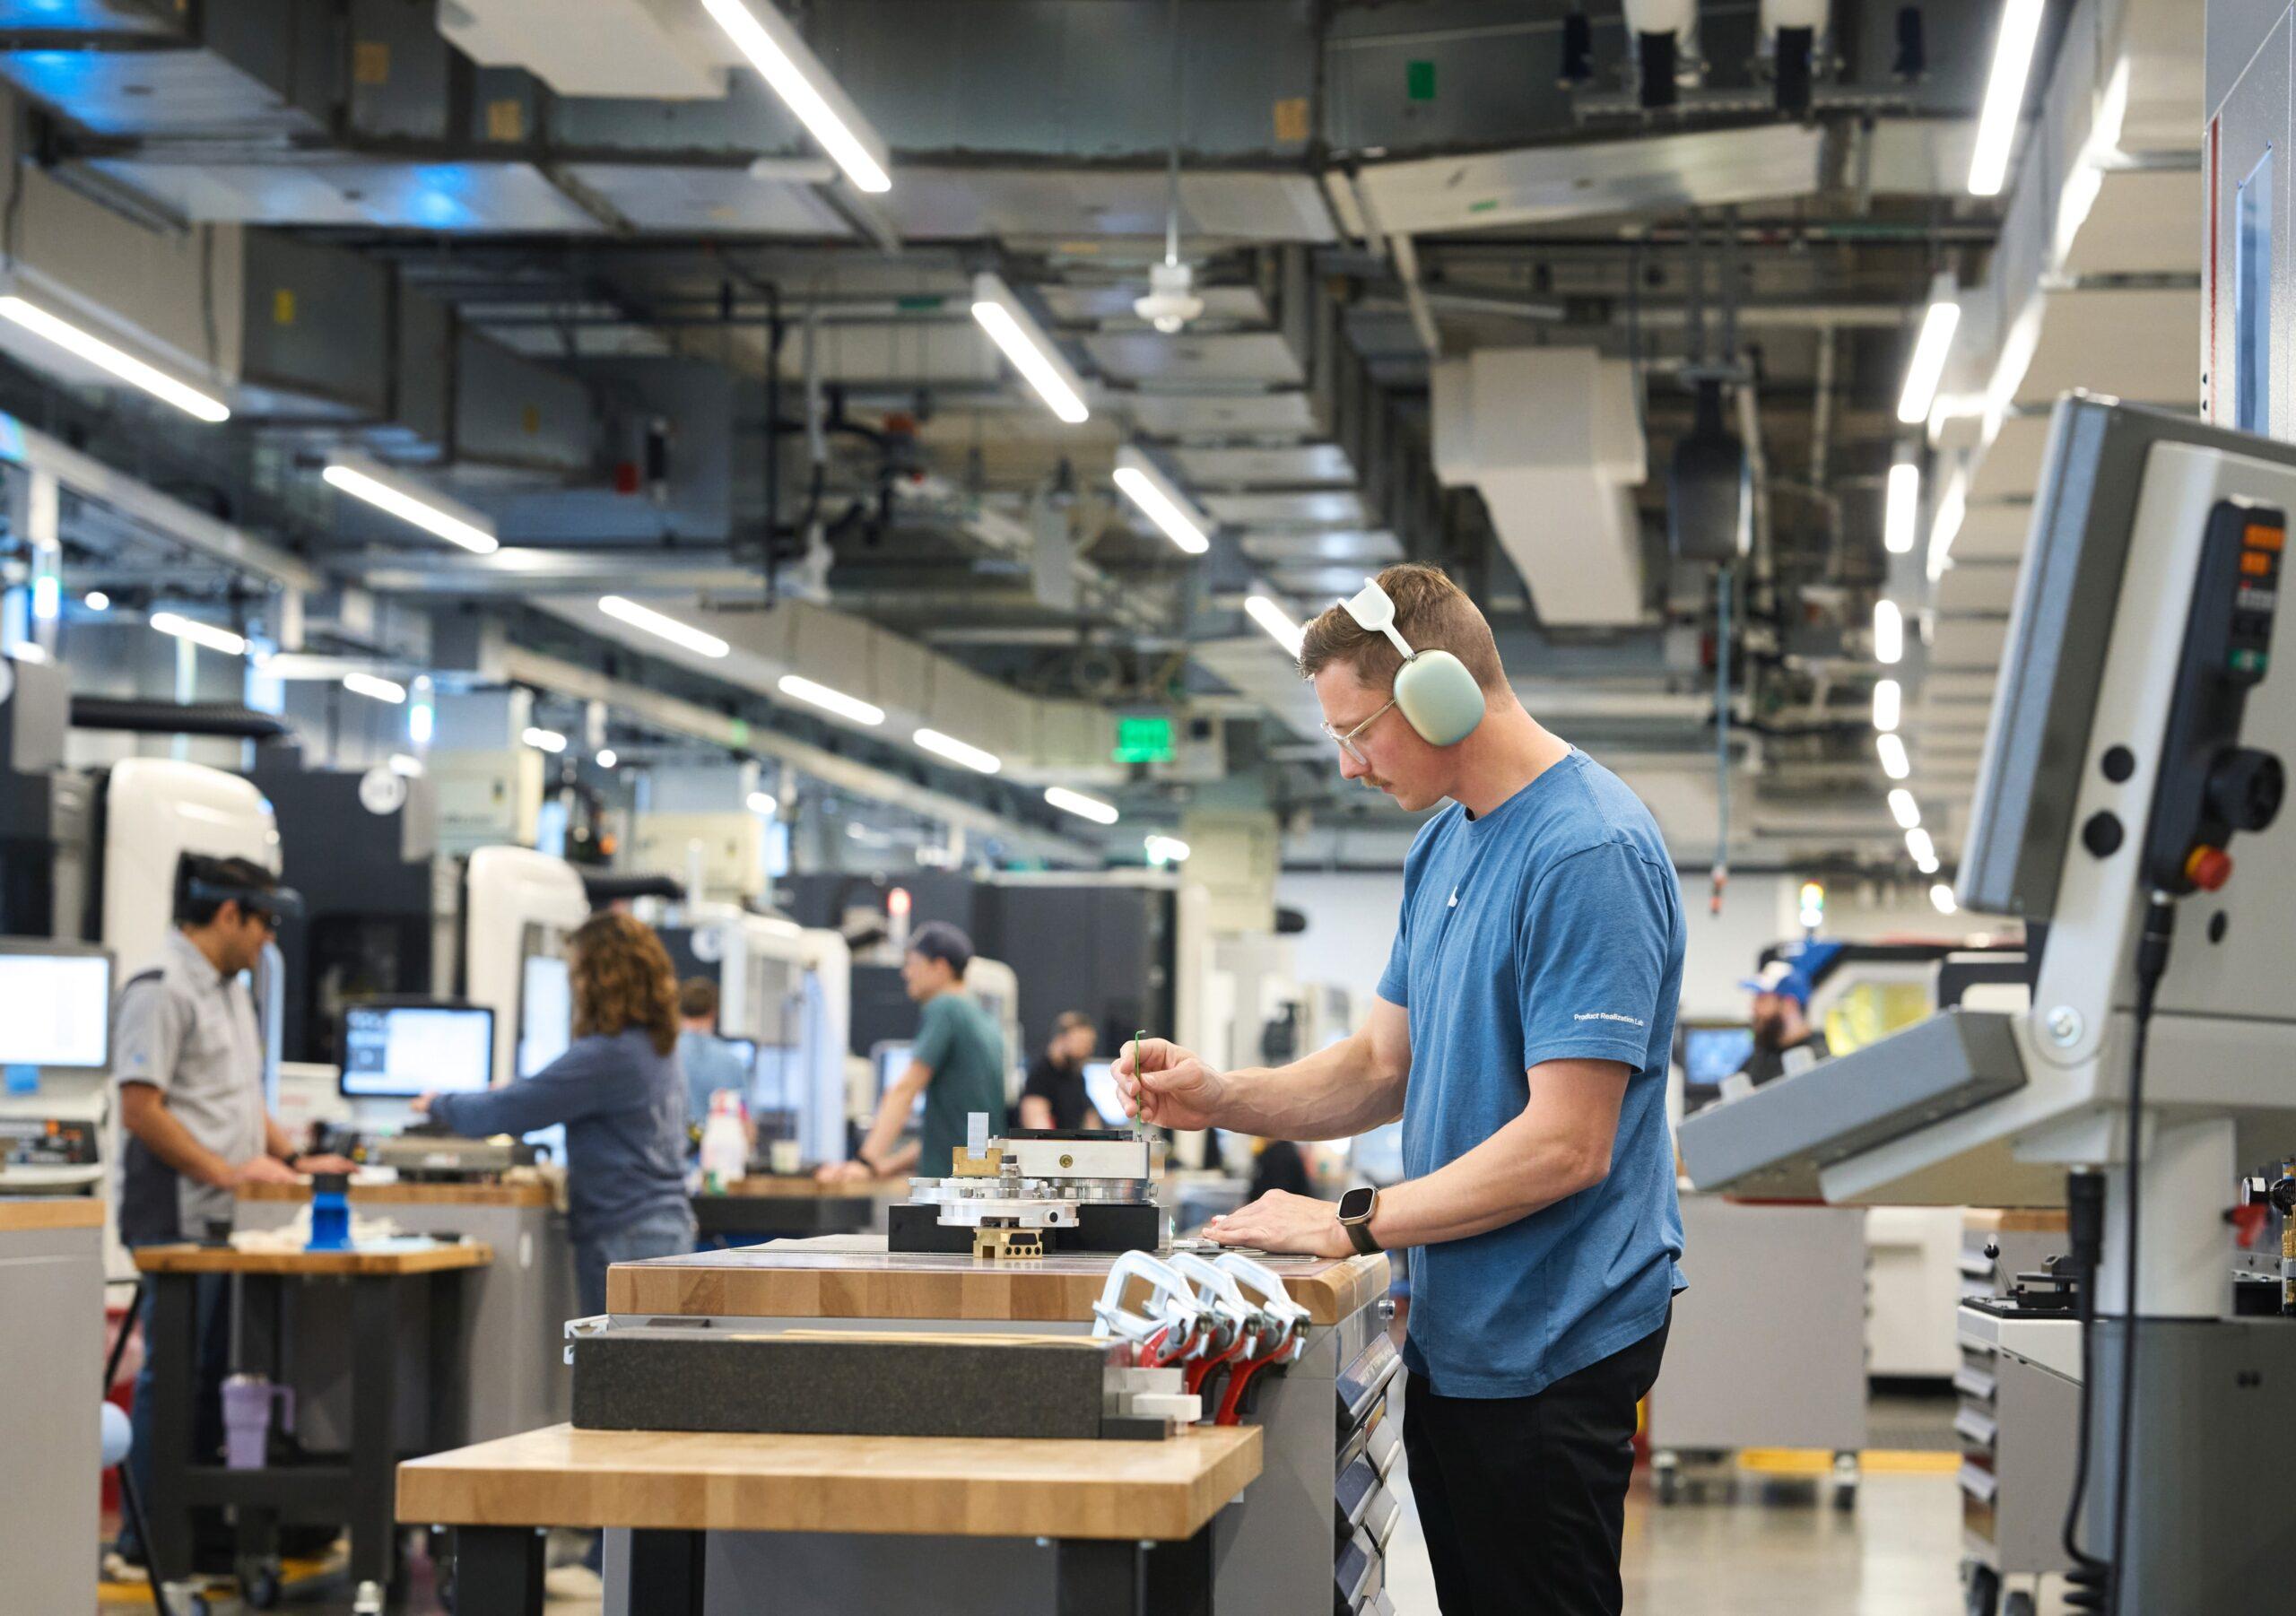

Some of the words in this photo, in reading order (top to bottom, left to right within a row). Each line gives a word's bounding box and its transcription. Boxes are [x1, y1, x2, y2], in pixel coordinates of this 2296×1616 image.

[1574, 1012, 1599, 1021] Product
[1600, 1012, 1635, 1024] Realization
[1635, 1018, 1644, 1027] Lab
